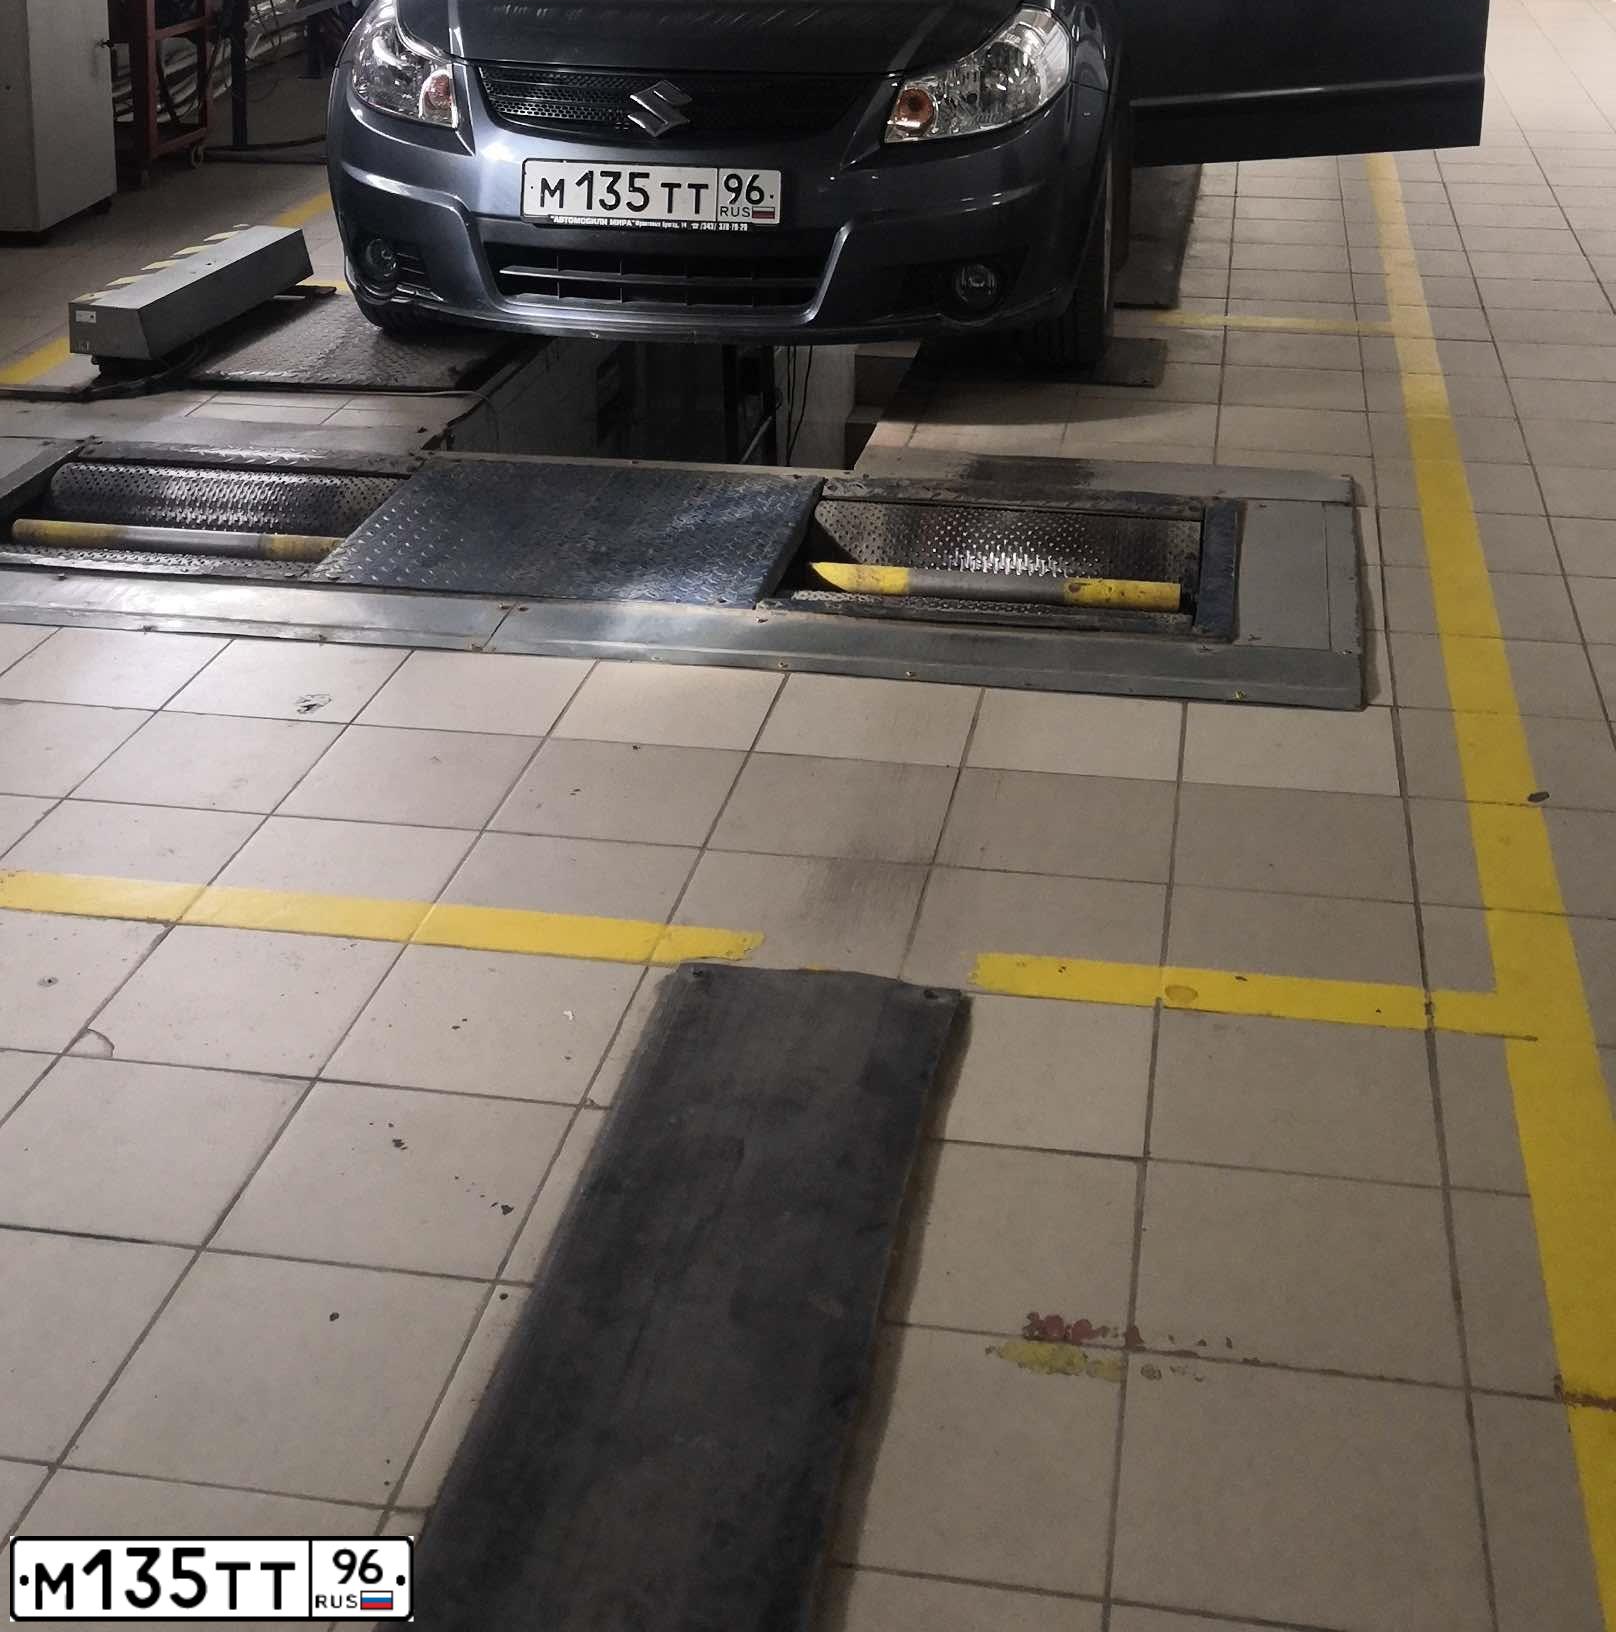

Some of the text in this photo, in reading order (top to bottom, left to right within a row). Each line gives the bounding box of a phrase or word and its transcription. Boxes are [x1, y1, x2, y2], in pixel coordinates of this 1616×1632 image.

[575, 170, 650, 213] 135
[723, 173, 766, 206] 96
[719, 206, 751, 218] RUS
